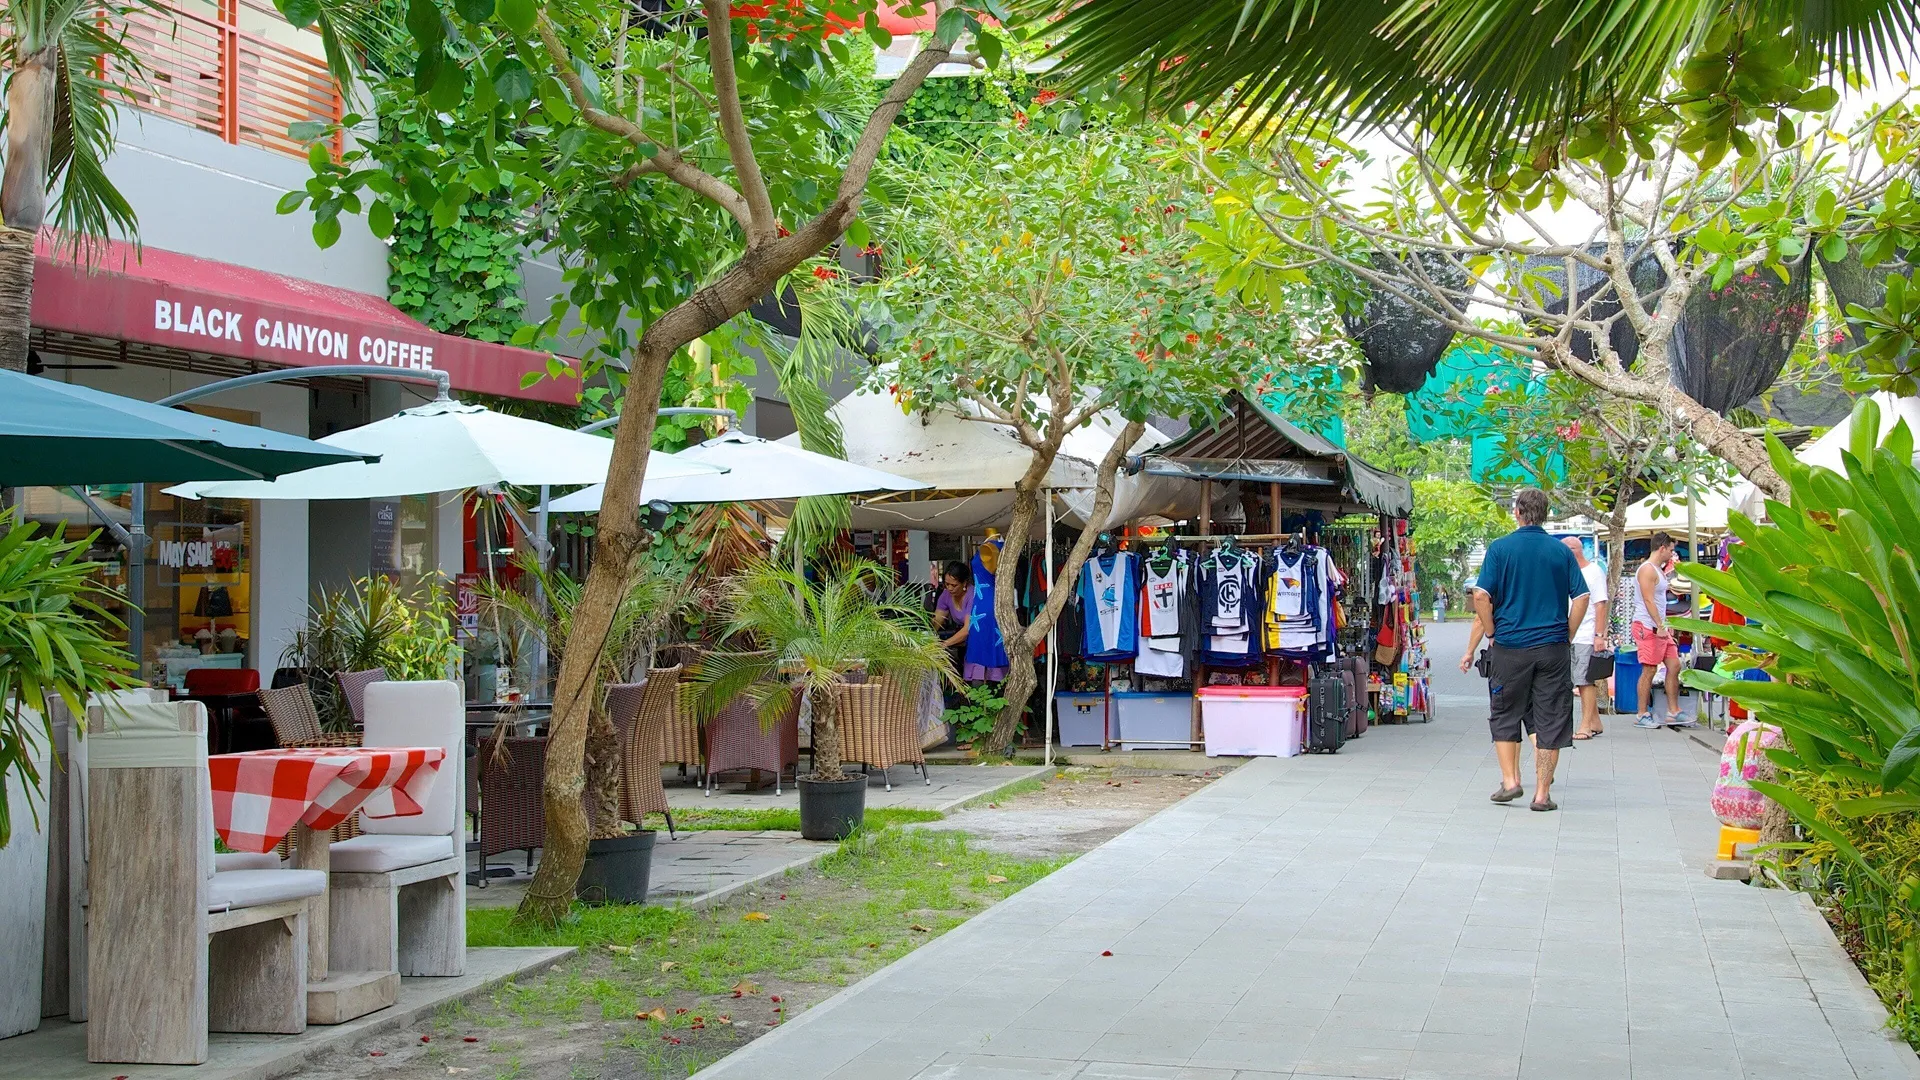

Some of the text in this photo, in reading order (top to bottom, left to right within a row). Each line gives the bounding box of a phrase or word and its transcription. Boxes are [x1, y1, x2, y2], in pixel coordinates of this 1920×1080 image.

[155, 300, 433, 370] BLACK CANYON COFFEE
[160, 541, 213, 567] MAY SALE
[216, 541, 230, 549] UP TO
